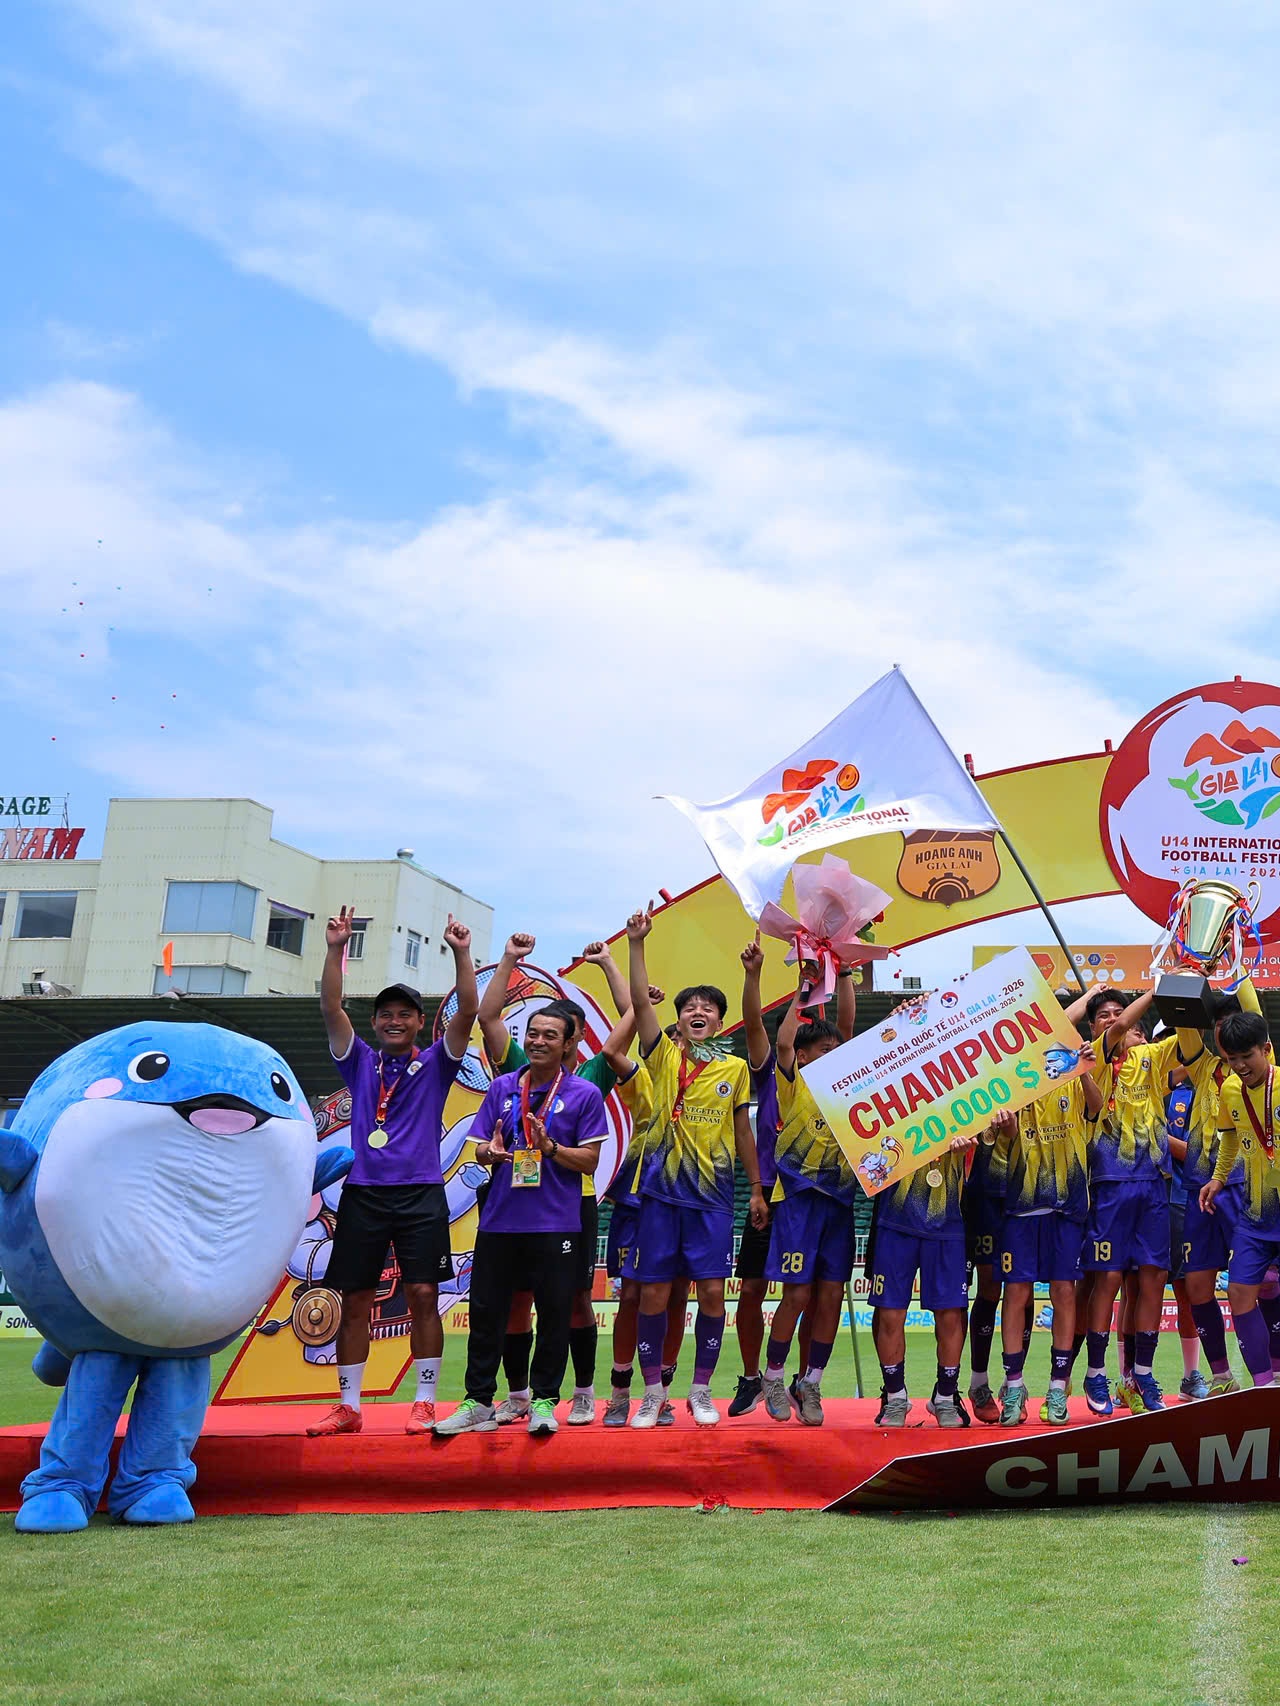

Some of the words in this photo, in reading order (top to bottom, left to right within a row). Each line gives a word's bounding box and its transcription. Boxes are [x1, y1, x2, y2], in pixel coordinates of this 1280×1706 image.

[1200, 769, 1239, 796] GIA
[1242, 756, 1268, 790] LAI
[1161, 836, 1189, 847] U14
[915, 848, 956, 864] HOANG
[959, 848, 983, 862] ANH
[927, 861, 948, 870] GIA
[951, 861, 972, 870] LAI
[1161, 850, 1237, 863] FOOTBALL
[1183, 867, 1206, 875] GIA
[832, 1065, 872, 1093] FESTIVAL
[947, 1011, 966, 1026] U14
[966, 1002, 981, 1016] GIA
[981, 994, 997, 1007] LAI
[1002, 978, 1025, 996] 2026
[851, 1083, 864, 1094] GIA
[864, 1077, 876, 1087] LAI
[875, 1069, 888, 1080] U14
[888, 1041, 937, 1073] INTERNATIONAL
[937, 1022, 970, 1044] FOOTBALL
[969, 1005, 999, 1026] FESTIVAL
[999, 995, 1017, 1009] 2026
[848, 1001, 1054, 1140] CHAMPION
[904, 1077, 1012, 1156] 20.000
[1014, 1059, 1041, 1091] $
[685, 1114, 720, 1124] VIETNAM
[1093, 1240, 1112, 1262] 19
[781, 1252, 804, 1273] 28
[1001, 1251, 1012, 1273] 8
